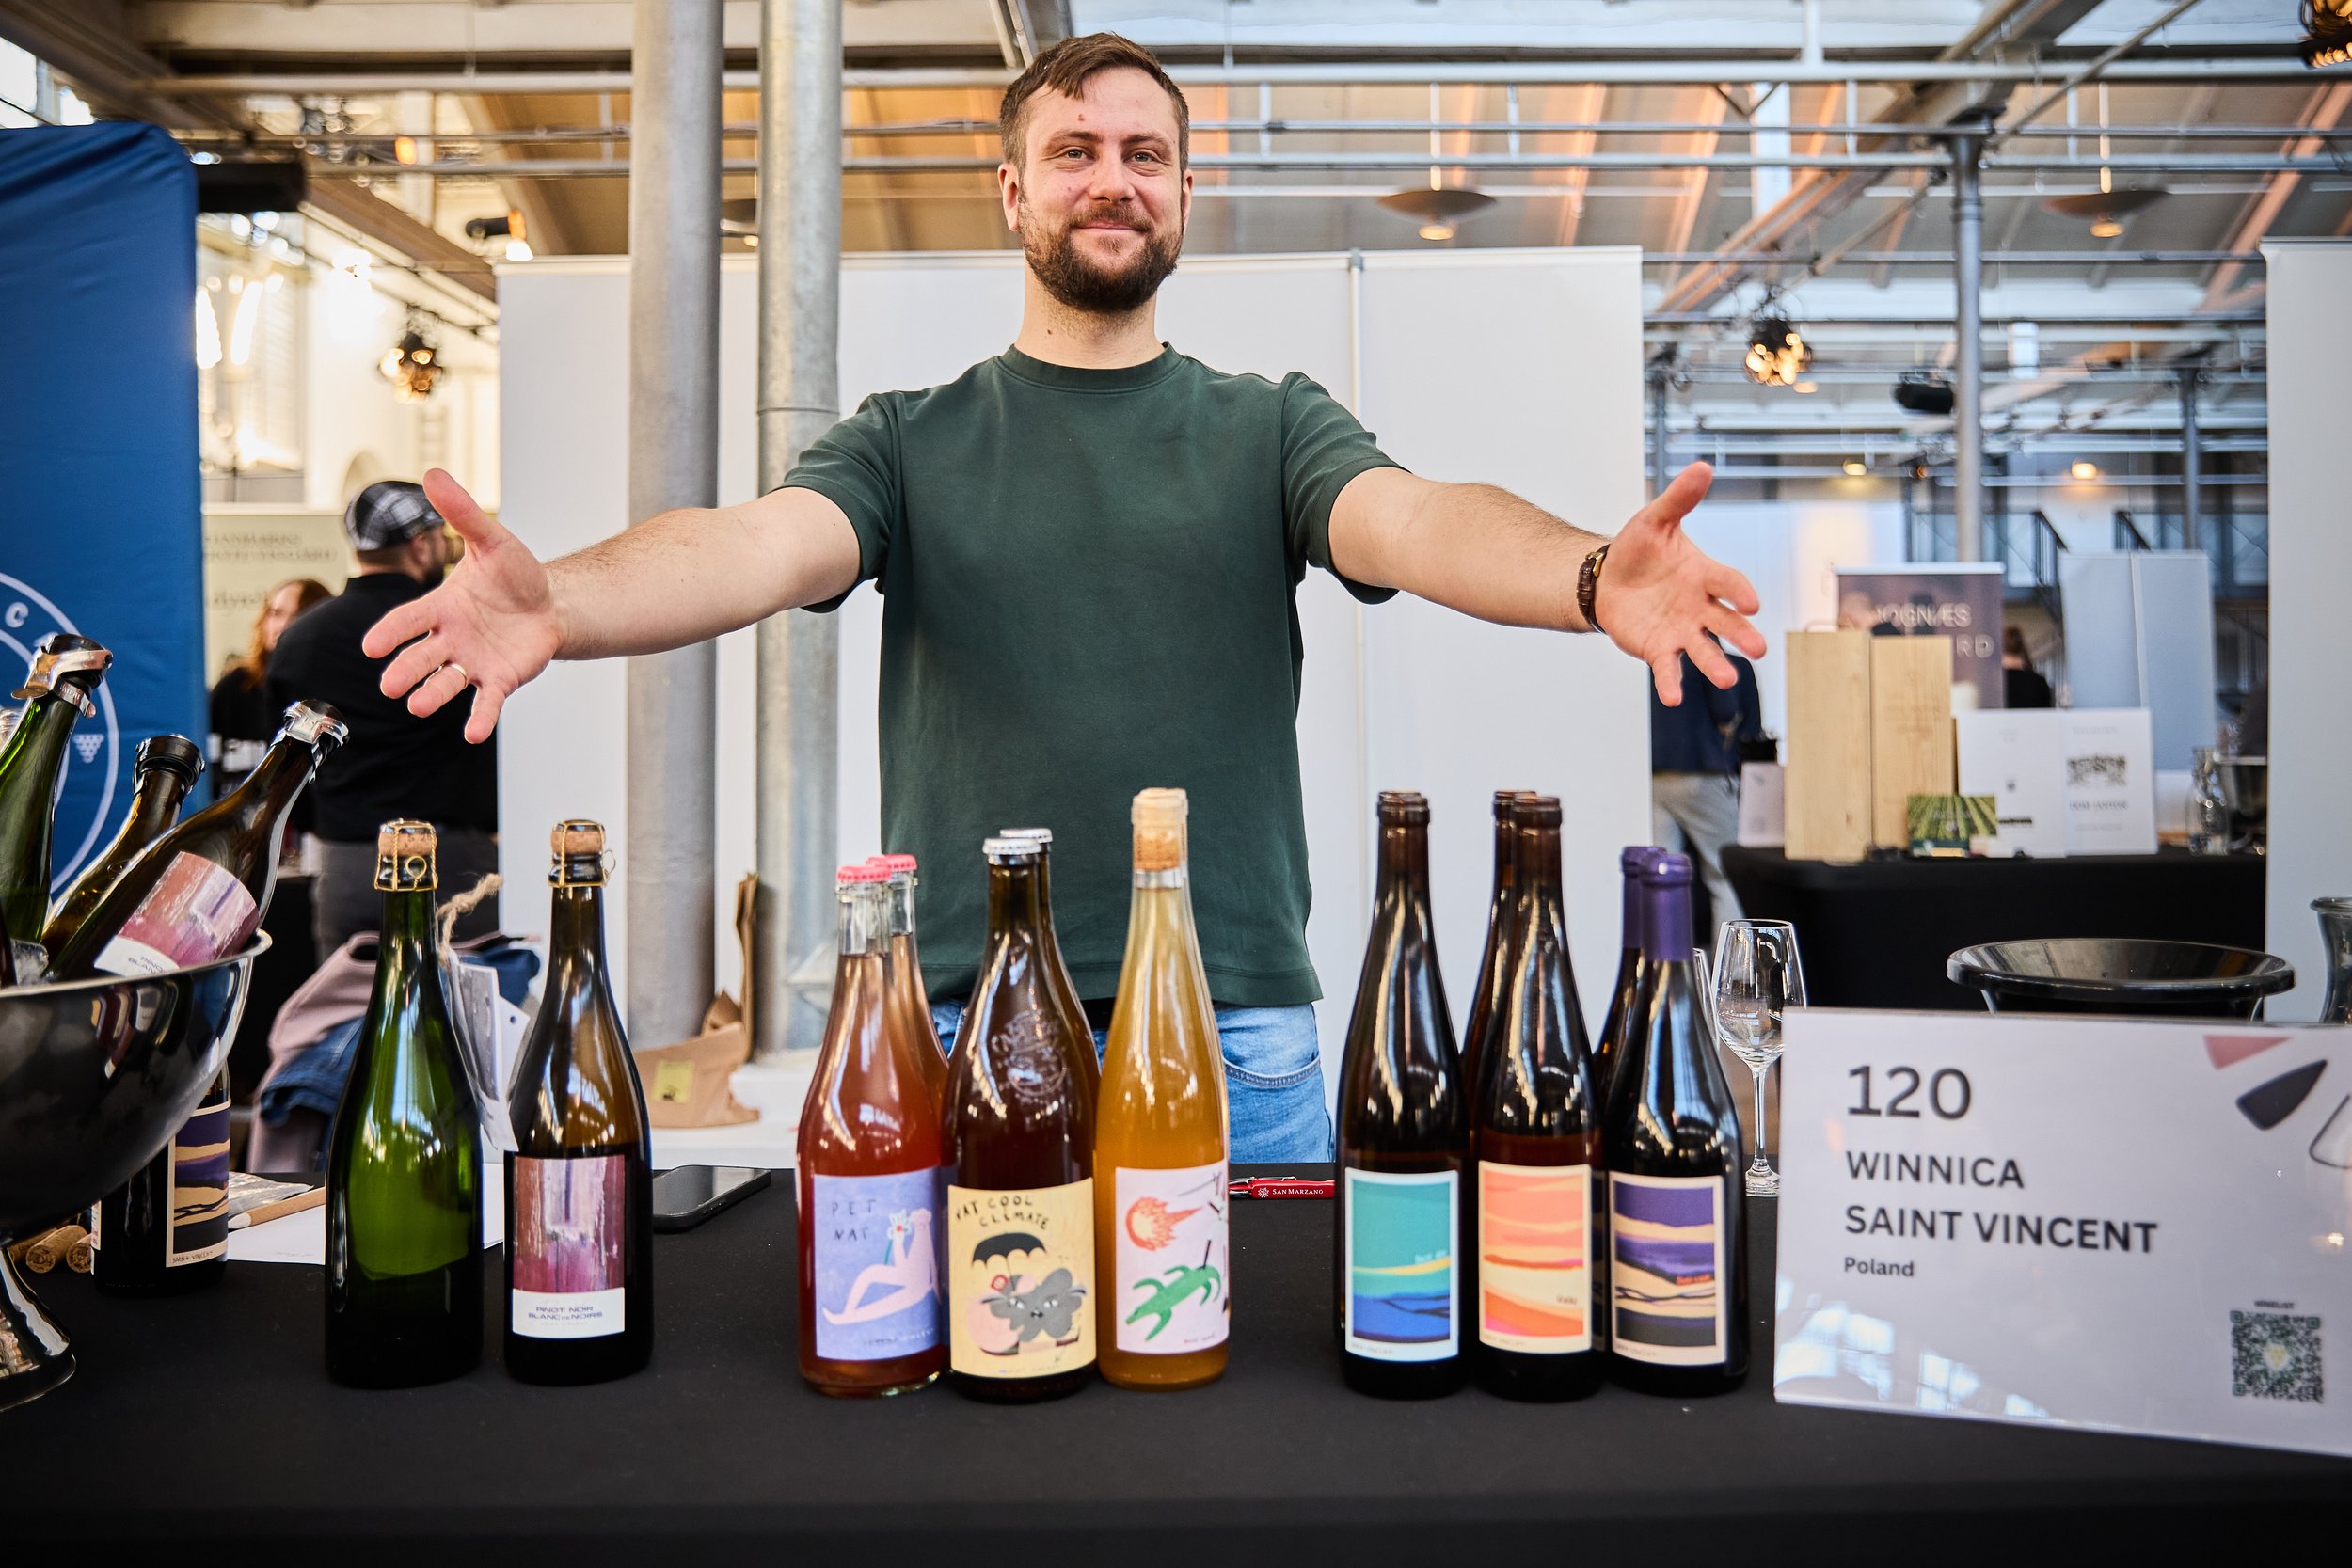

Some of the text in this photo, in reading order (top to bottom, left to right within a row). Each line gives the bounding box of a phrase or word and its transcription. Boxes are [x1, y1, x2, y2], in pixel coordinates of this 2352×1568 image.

[1847, 1064, 1972, 1120] 120
[1846, 1150, 2025, 1189] WINNICA
[832, 1198, 877, 1217] PET
[988, 1196, 1032, 1208] COOL
[979, 1211, 1049, 1229] CLIMATE
[1845, 1205, 2158, 1254] SAINT VINCENT
[834, 1227, 868, 1241] NAT
[1844, 1257, 1915, 1277] Poland
